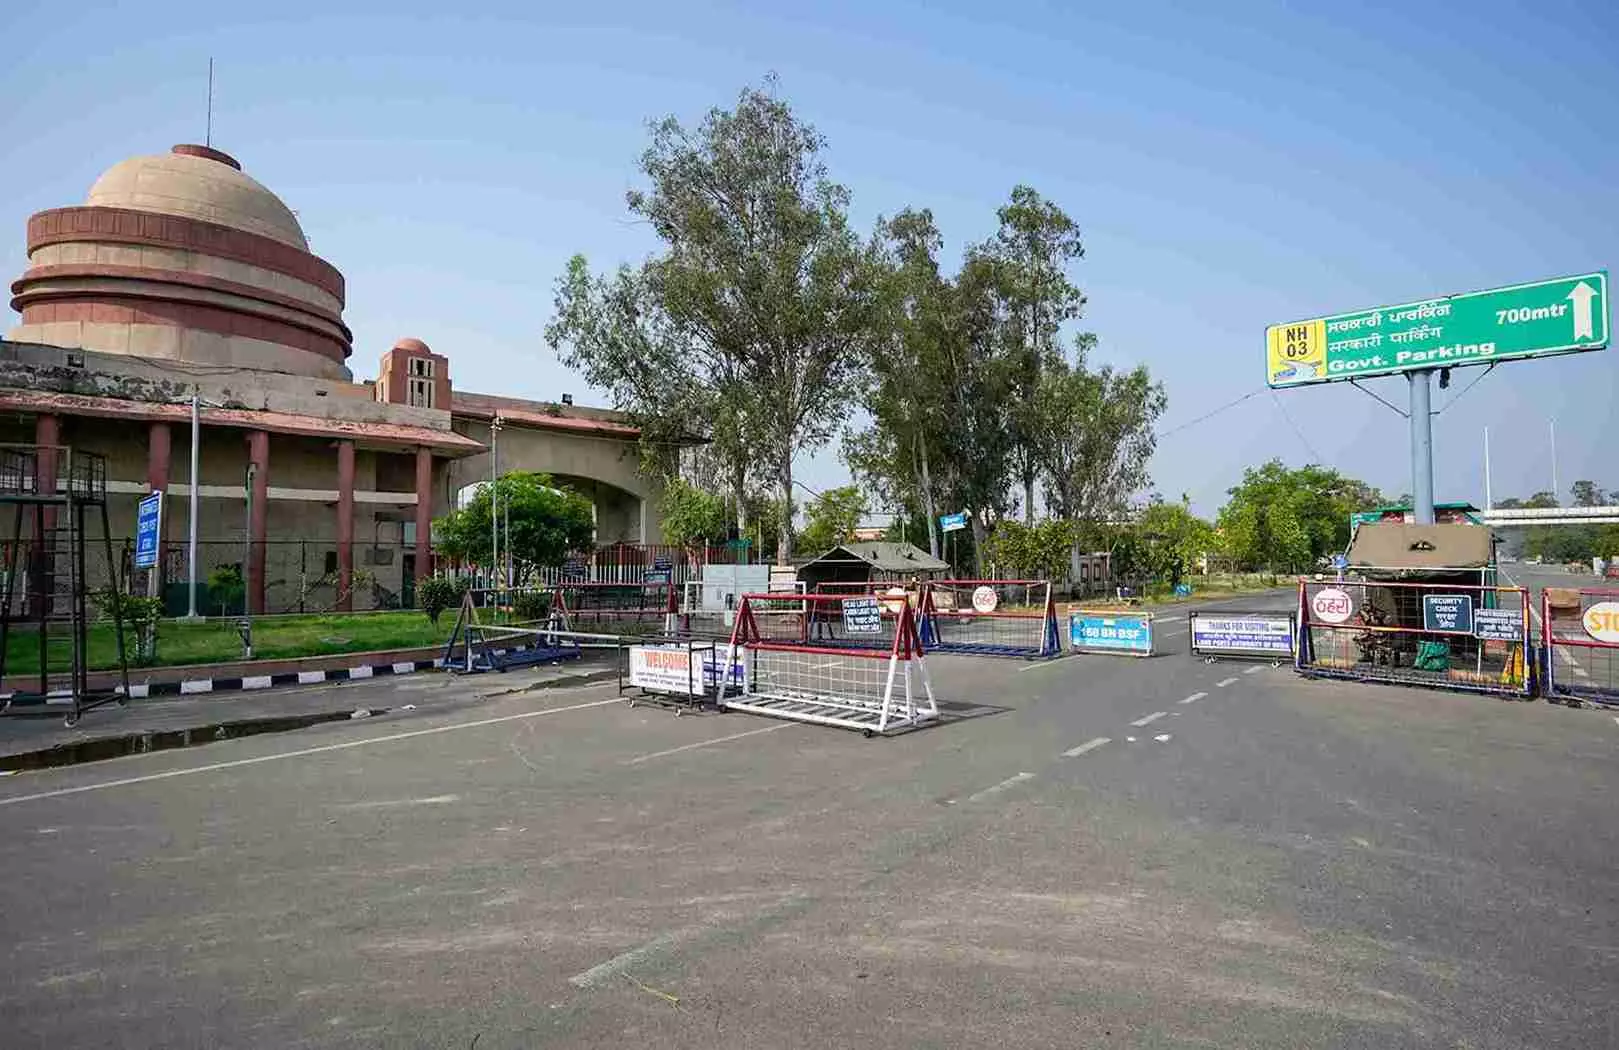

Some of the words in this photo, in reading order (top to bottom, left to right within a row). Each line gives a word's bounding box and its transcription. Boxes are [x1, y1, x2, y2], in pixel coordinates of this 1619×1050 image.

[1496, 303, 1567, 325] 700mtr
[1287, 327, 1307, 342] NH
[1329, 334, 1382, 353] सरकारी
[1287, 343, 1307, 358] 03
[1329, 355, 1388, 371] Govt.
[1396, 342, 1496, 364] Parking
